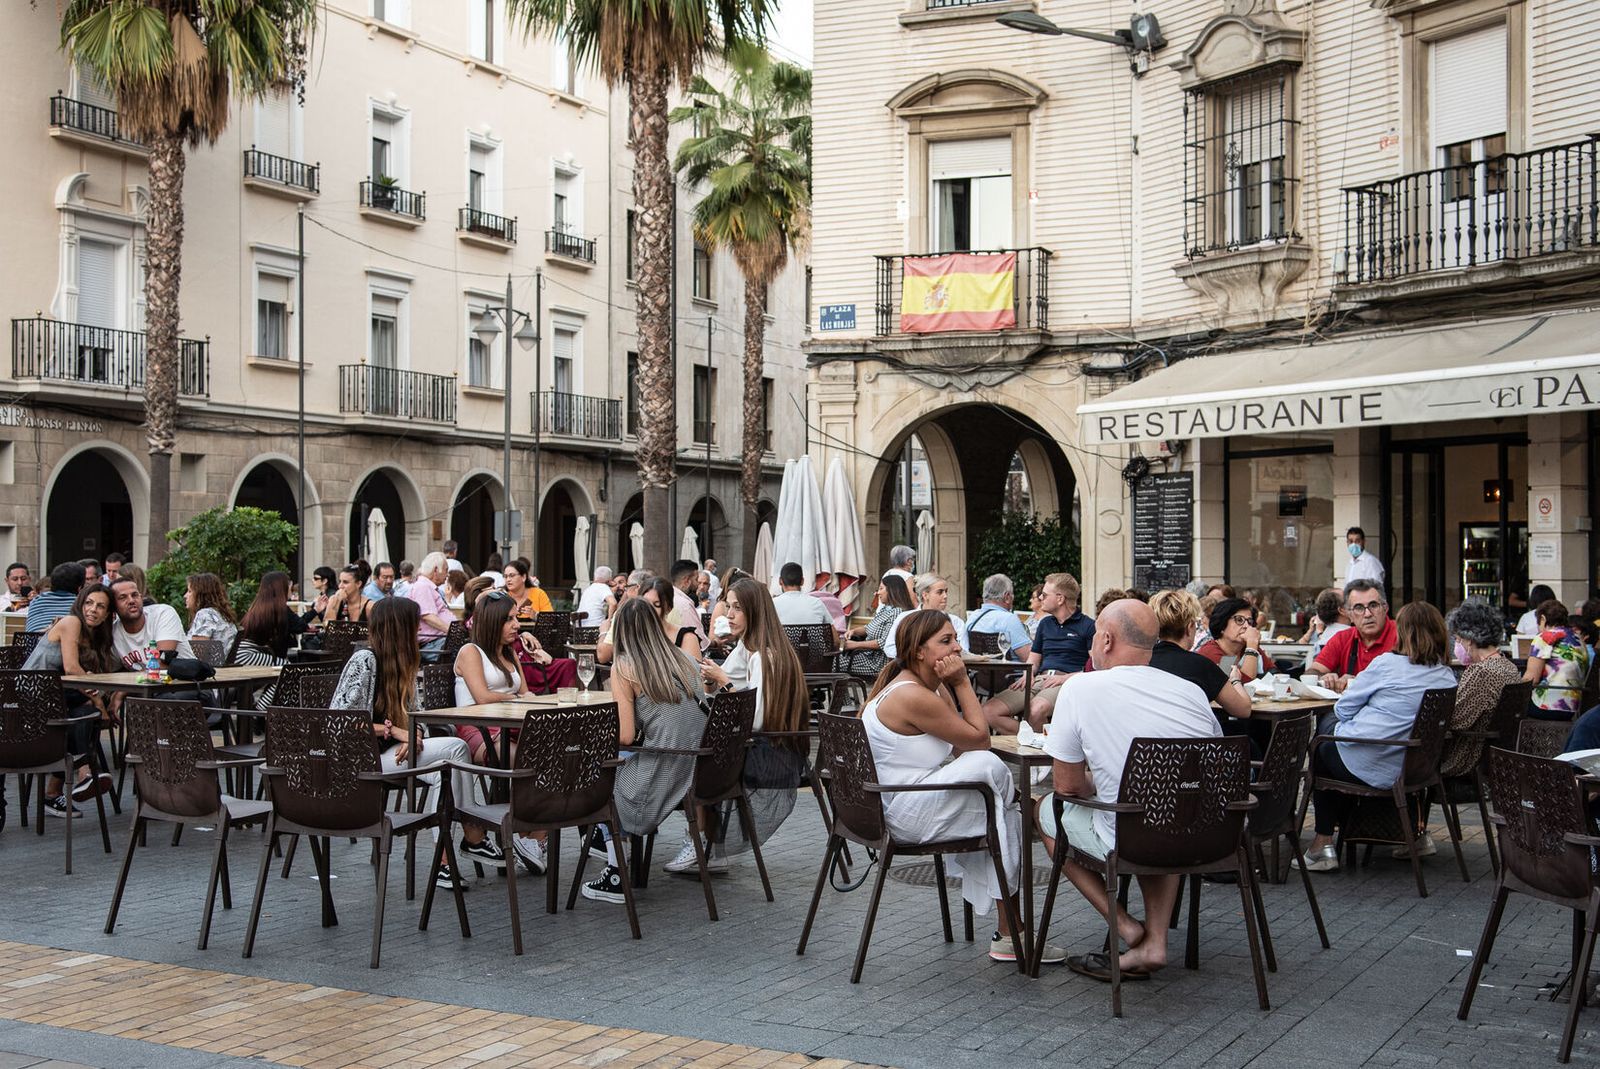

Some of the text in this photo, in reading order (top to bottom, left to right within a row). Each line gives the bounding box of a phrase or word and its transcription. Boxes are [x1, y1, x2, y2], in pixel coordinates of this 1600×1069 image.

[822, 321, 832, 329] LAS
[1099, 372, 1600, 441] RESTAURANTE El PA
